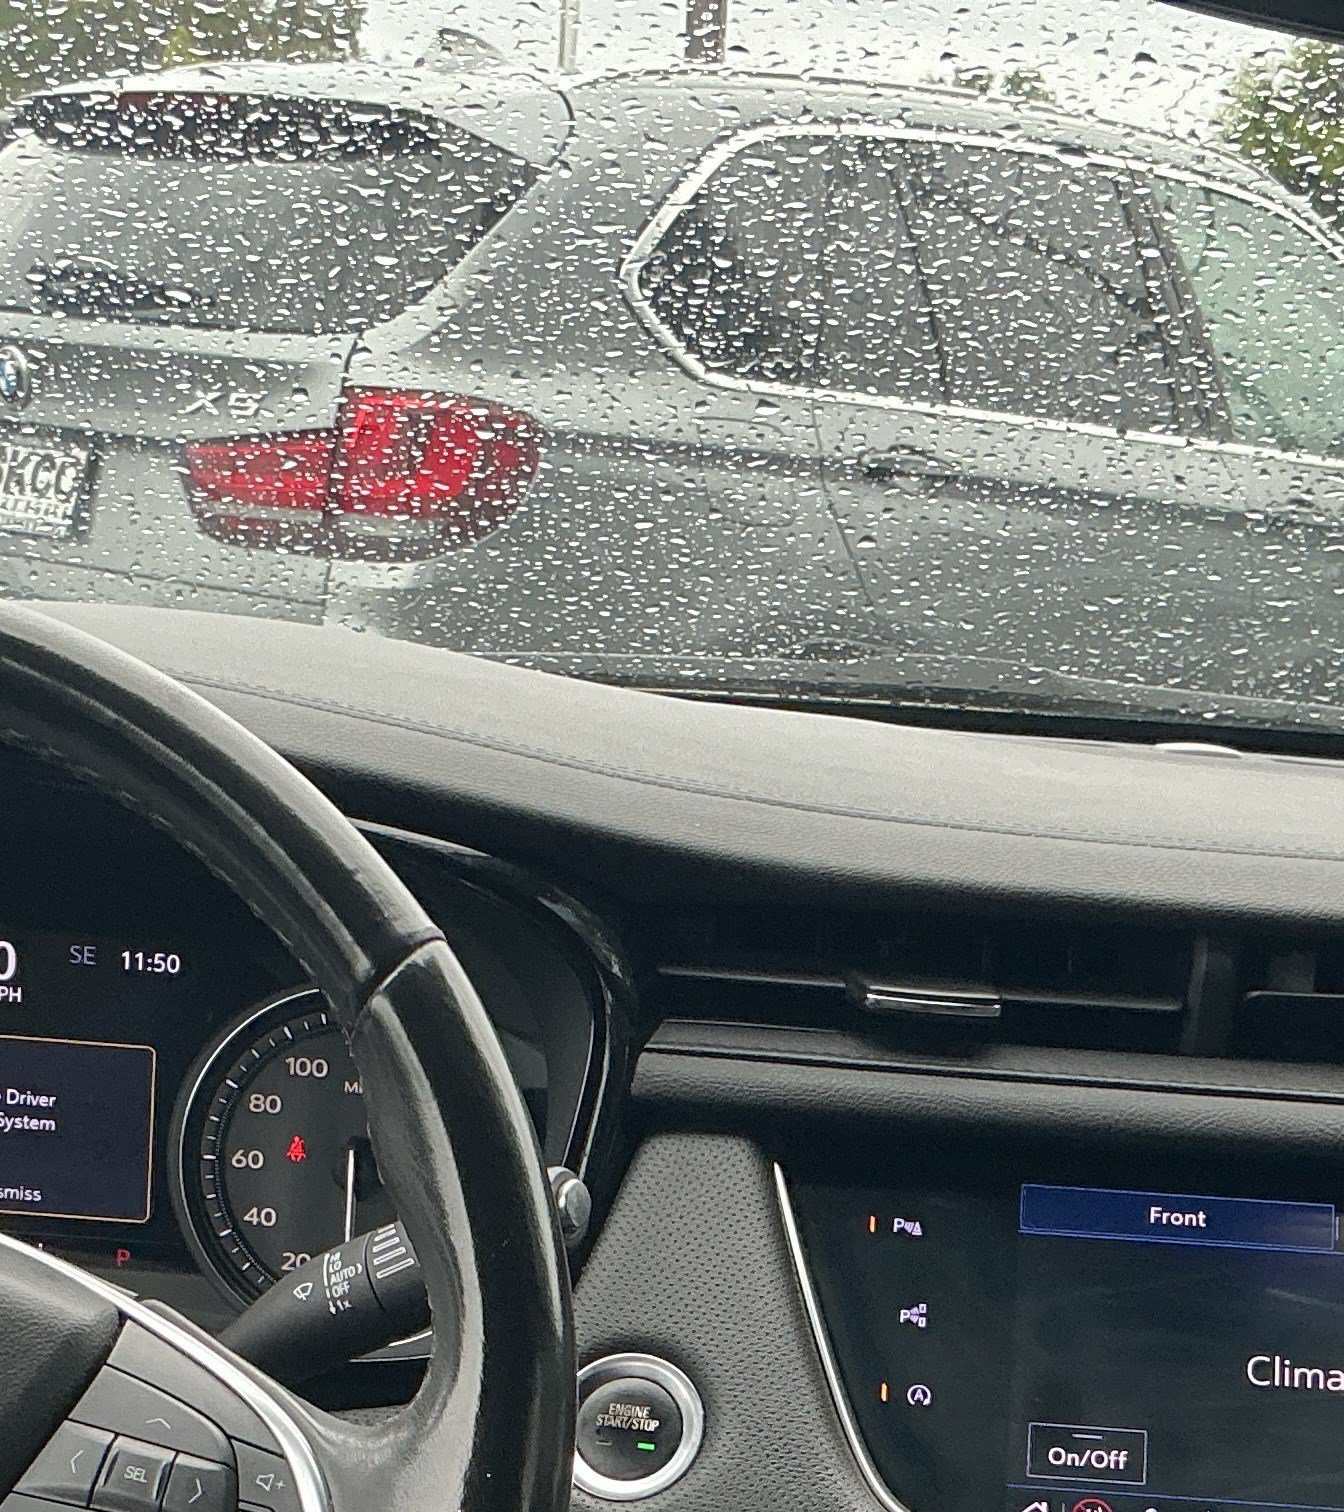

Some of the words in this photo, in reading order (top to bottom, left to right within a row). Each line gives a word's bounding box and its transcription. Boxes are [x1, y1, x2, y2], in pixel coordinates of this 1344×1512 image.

[177, 390, 264, 416] X5
[69, 945, 96, 966] SE
[121, 950, 181, 975] 11:50
[285, 1057, 329, 1079] 100
[6, 1088, 57, 1108] Driver
[248, 1094, 282, 1114] 80
[231, 1150, 264, 1170] 60
[243, 1207, 277, 1228] 40
[1149, 1206, 1207, 1228] Front
[329, 1264, 356, 1286] AUTO
[331, 1280, 351, 1298] OFF
[608, 1402, 651, 1419] ENGINE
[596, 1413, 660, 1432] START/STOP
[1048, 1446, 1129, 1471] On/Off
[123, 1465, 148, 1484] SEL
